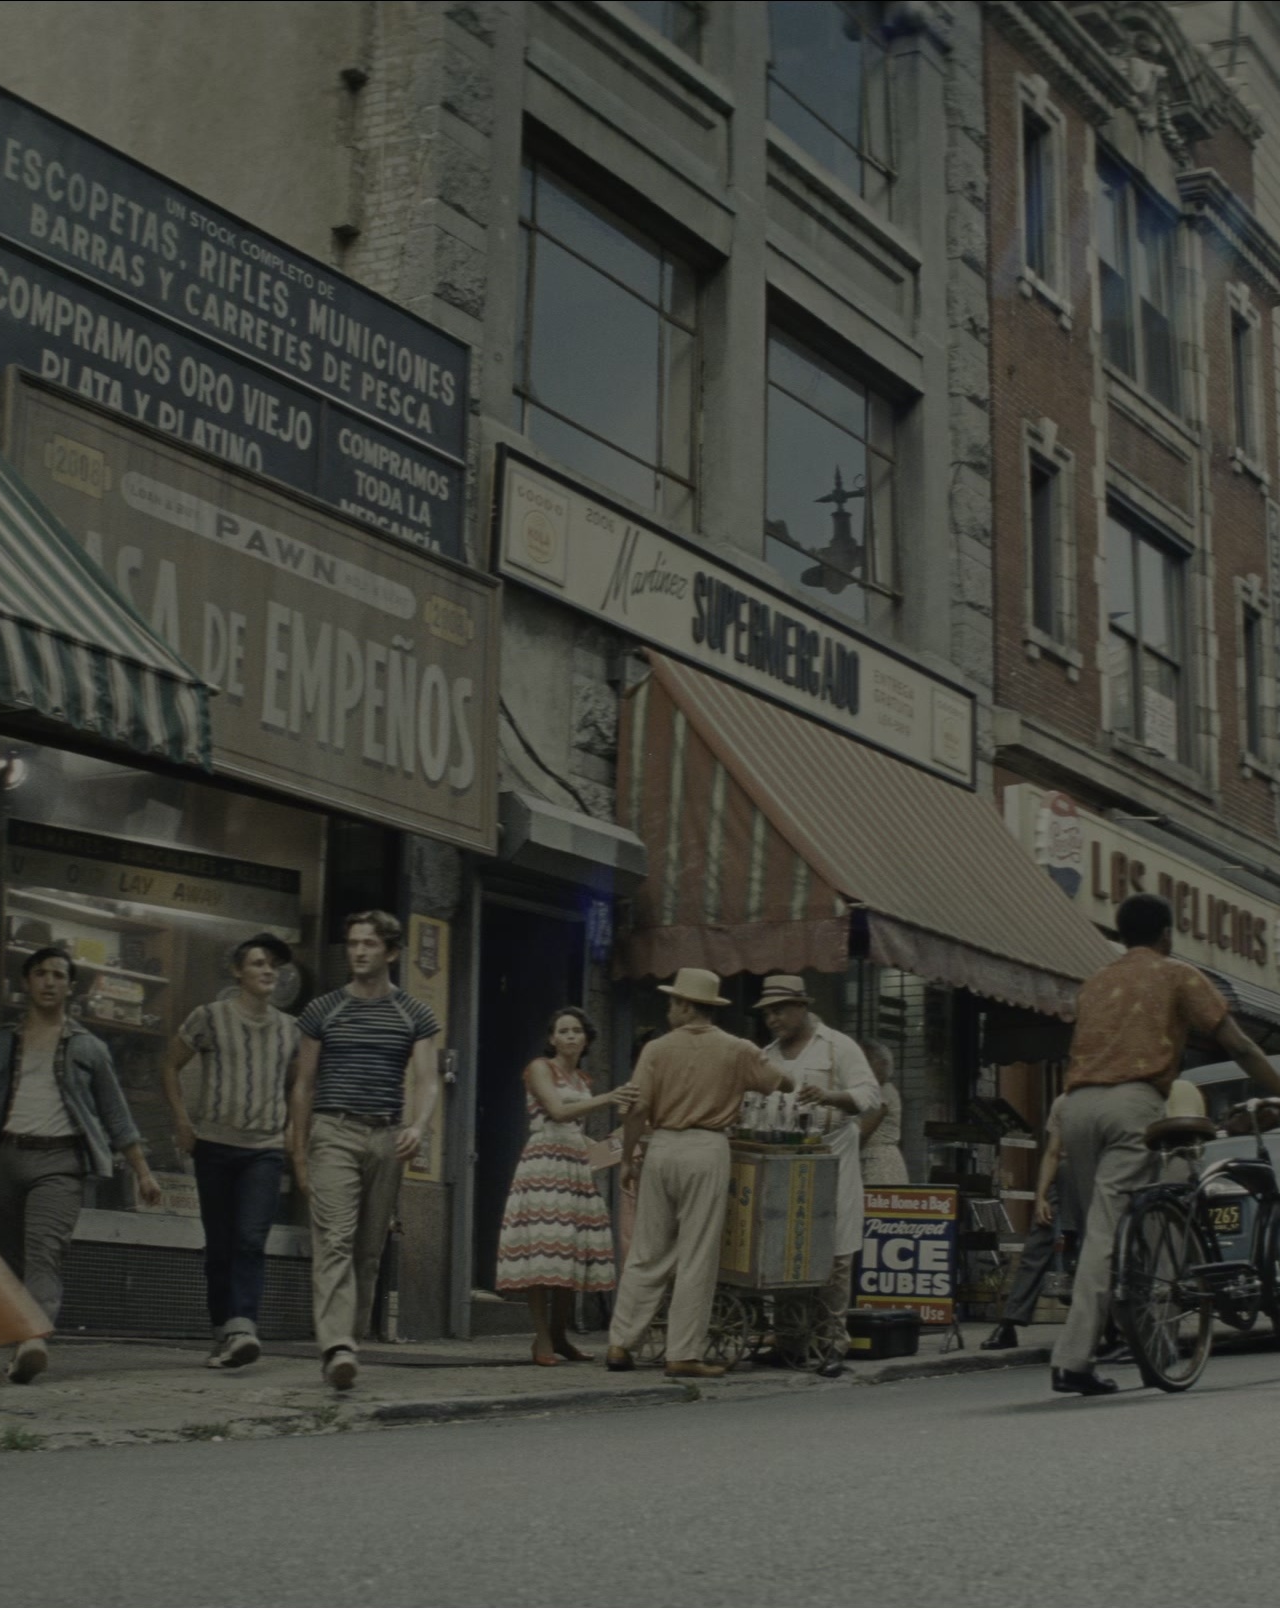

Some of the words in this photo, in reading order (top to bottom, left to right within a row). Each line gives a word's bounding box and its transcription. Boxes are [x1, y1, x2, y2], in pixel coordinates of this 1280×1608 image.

[165, 197, 186, 221] UN
[189, 210, 237, 250] STOCK
[240, 239, 315, 289] COMPLETO
[317, 278, 337, 302] DE
[29, 203, 145, 288] BARRAS
[157, 266, 175, 301] Y
[184, 284, 312, 372] CARRETES
[322, 351, 353, 393] DE
[361, 372, 433, 434] PESCA
[309, 299, 455, 406] MUNICIONES
[133, 389, 150, 420] Y
[179, 356, 235, 414] ORO
[242, 383, 313, 450] VIEJO
[337, 427, 449, 500] COMPRAMOS
[353, 469, 404, 515] TODA
[407, 494, 431, 527] LA
[216, 513, 336, 585] PAWN
[600, 526, 688, 616] Martinez
[692, 571, 860, 716] SUPERMERCADO
[203, 602, 246, 697] DE
[261, 600, 474, 790] EMPEÑOS
[119, 870, 154, 896] LAY
[863, 1218, 949, 1240] Packaged
[865, 1193, 890, 1209] Take
[891, 1194, 920, 1211] Home
[921, 1202, 928, 1211] a
[859, 1269, 952, 1297] CUBES
[861, 1237, 951, 1272] ICE
[920, 1304, 946, 1321] Use
